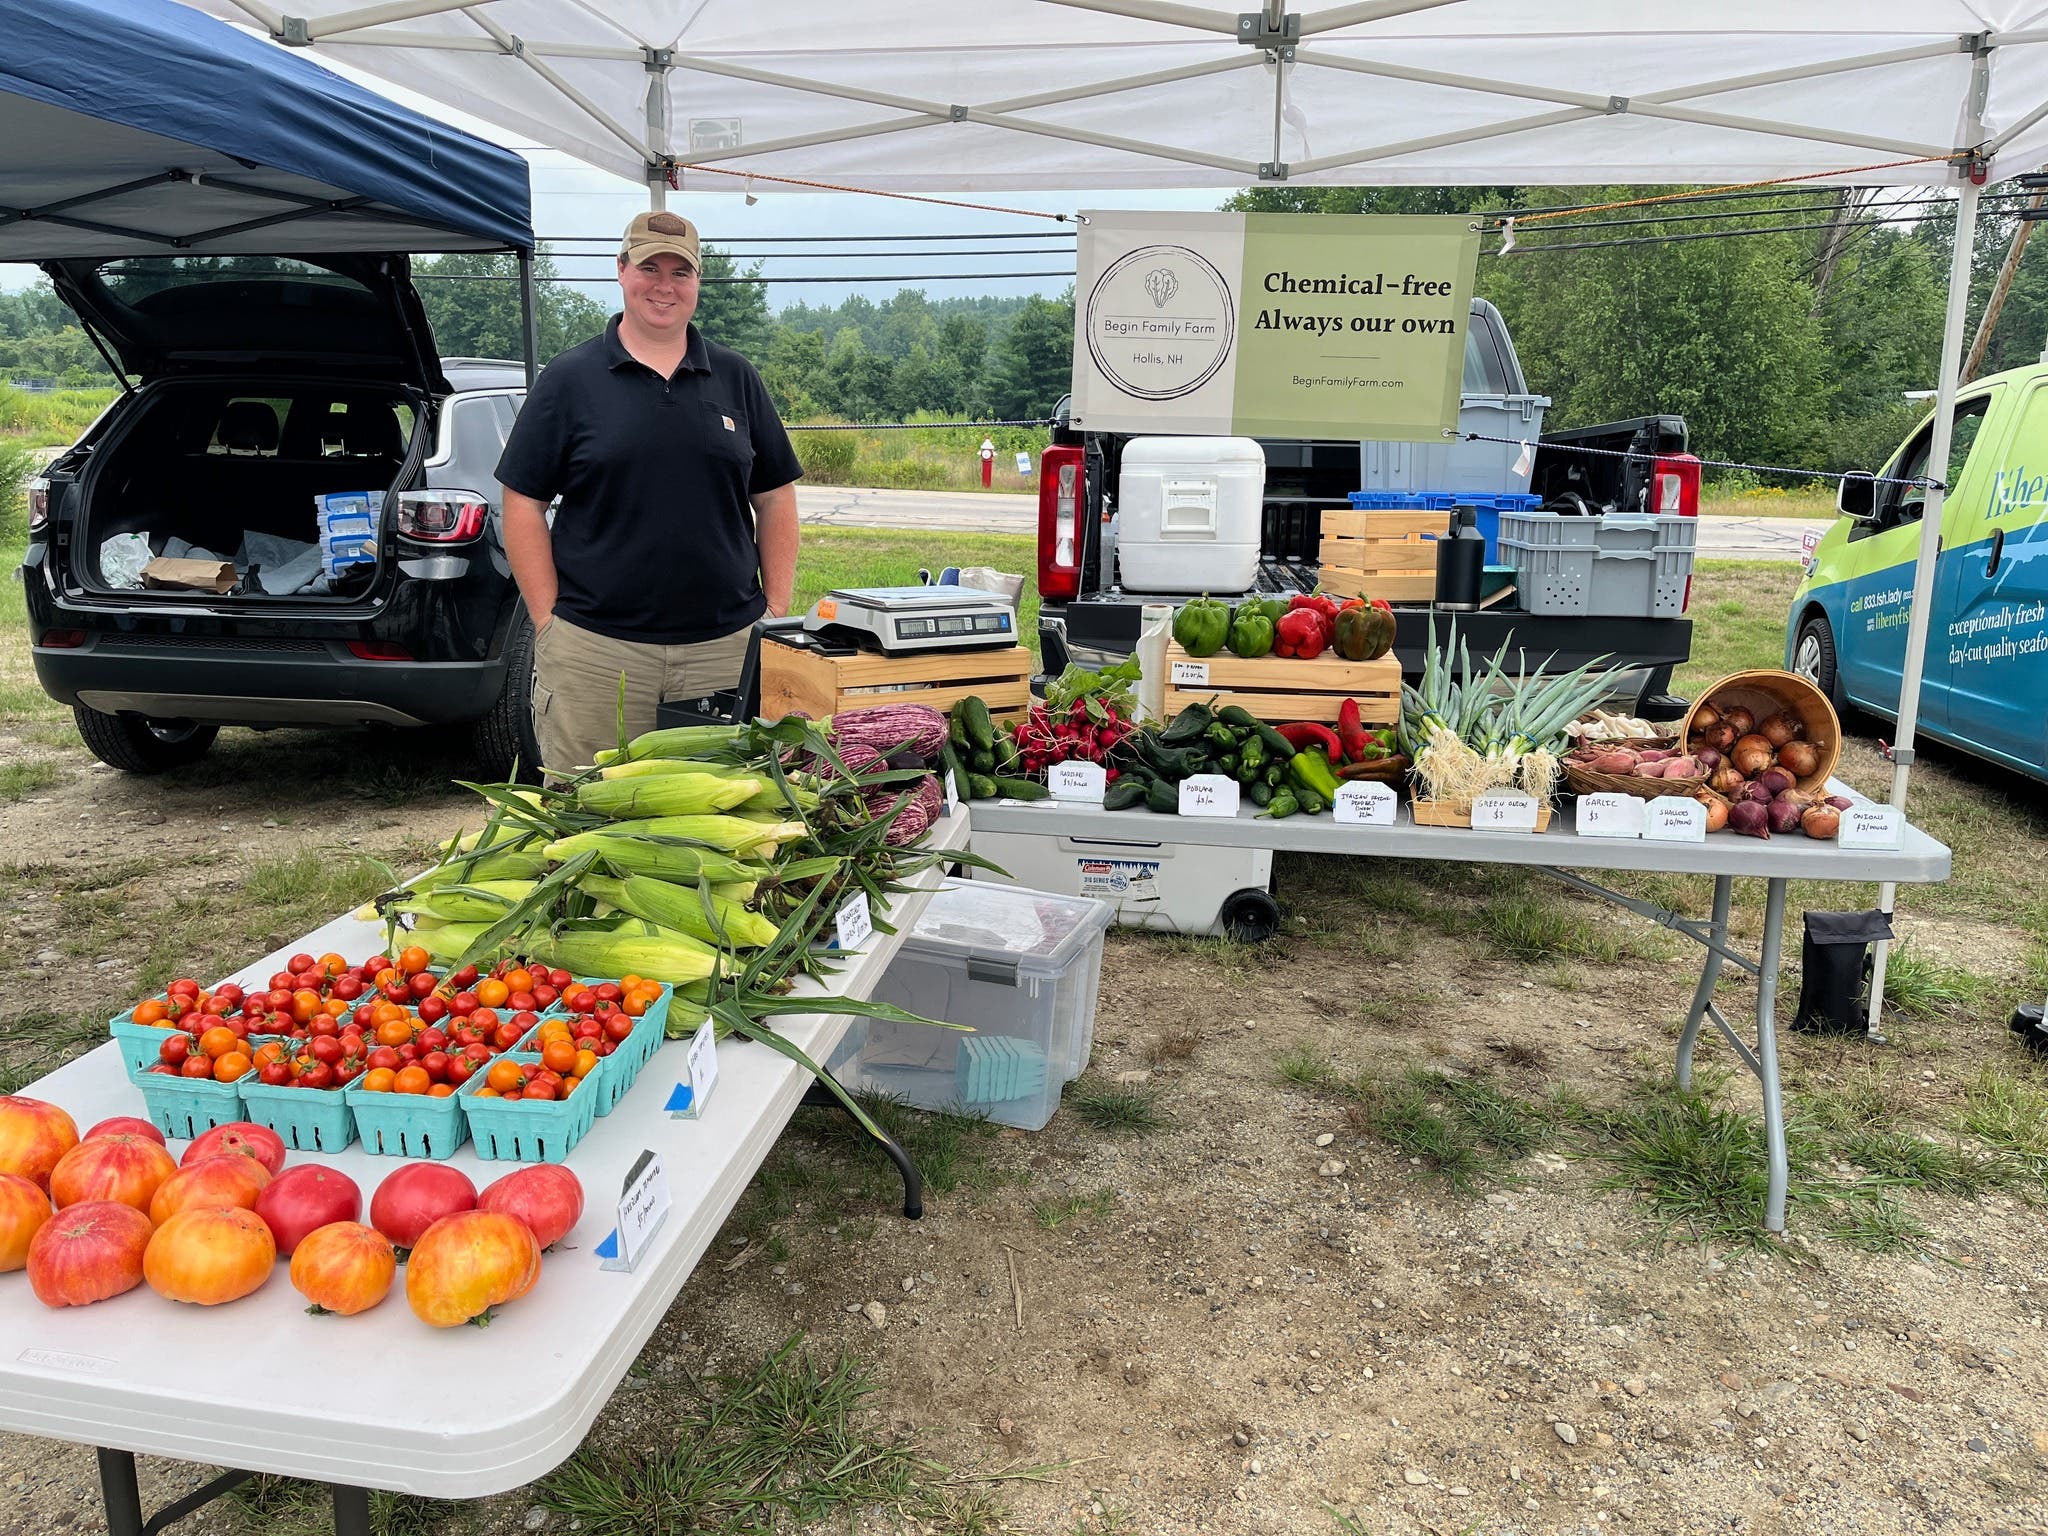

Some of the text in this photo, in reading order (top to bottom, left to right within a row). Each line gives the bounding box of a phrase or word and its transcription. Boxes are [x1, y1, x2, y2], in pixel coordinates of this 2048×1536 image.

[1263, 271, 1453, 298] Chemical-free
[1104, 319, 1216, 336] Begin Family Farm
[1254, 309, 1457, 337] Always our own
[1132, 351, 1184, 366] Hollis, NH
[1292, 374, 1405, 390] BeginFamilyFarm.com
[1850, 596, 1864, 613] call
[1948, 599, 2046, 639] exceptionally fresh
[1949, 642, 1983, 669] day-cut
[1983, 635, 2019, 665] quality
[1478, 800, 1505, 808] GREEN
[1585, 797, 1618, 807] GARLIC
[1492, 808, 1504, 820] $3
[1589, 809, 1599, 822] $3
[1852, 813, 1884, 821] ONIONS
